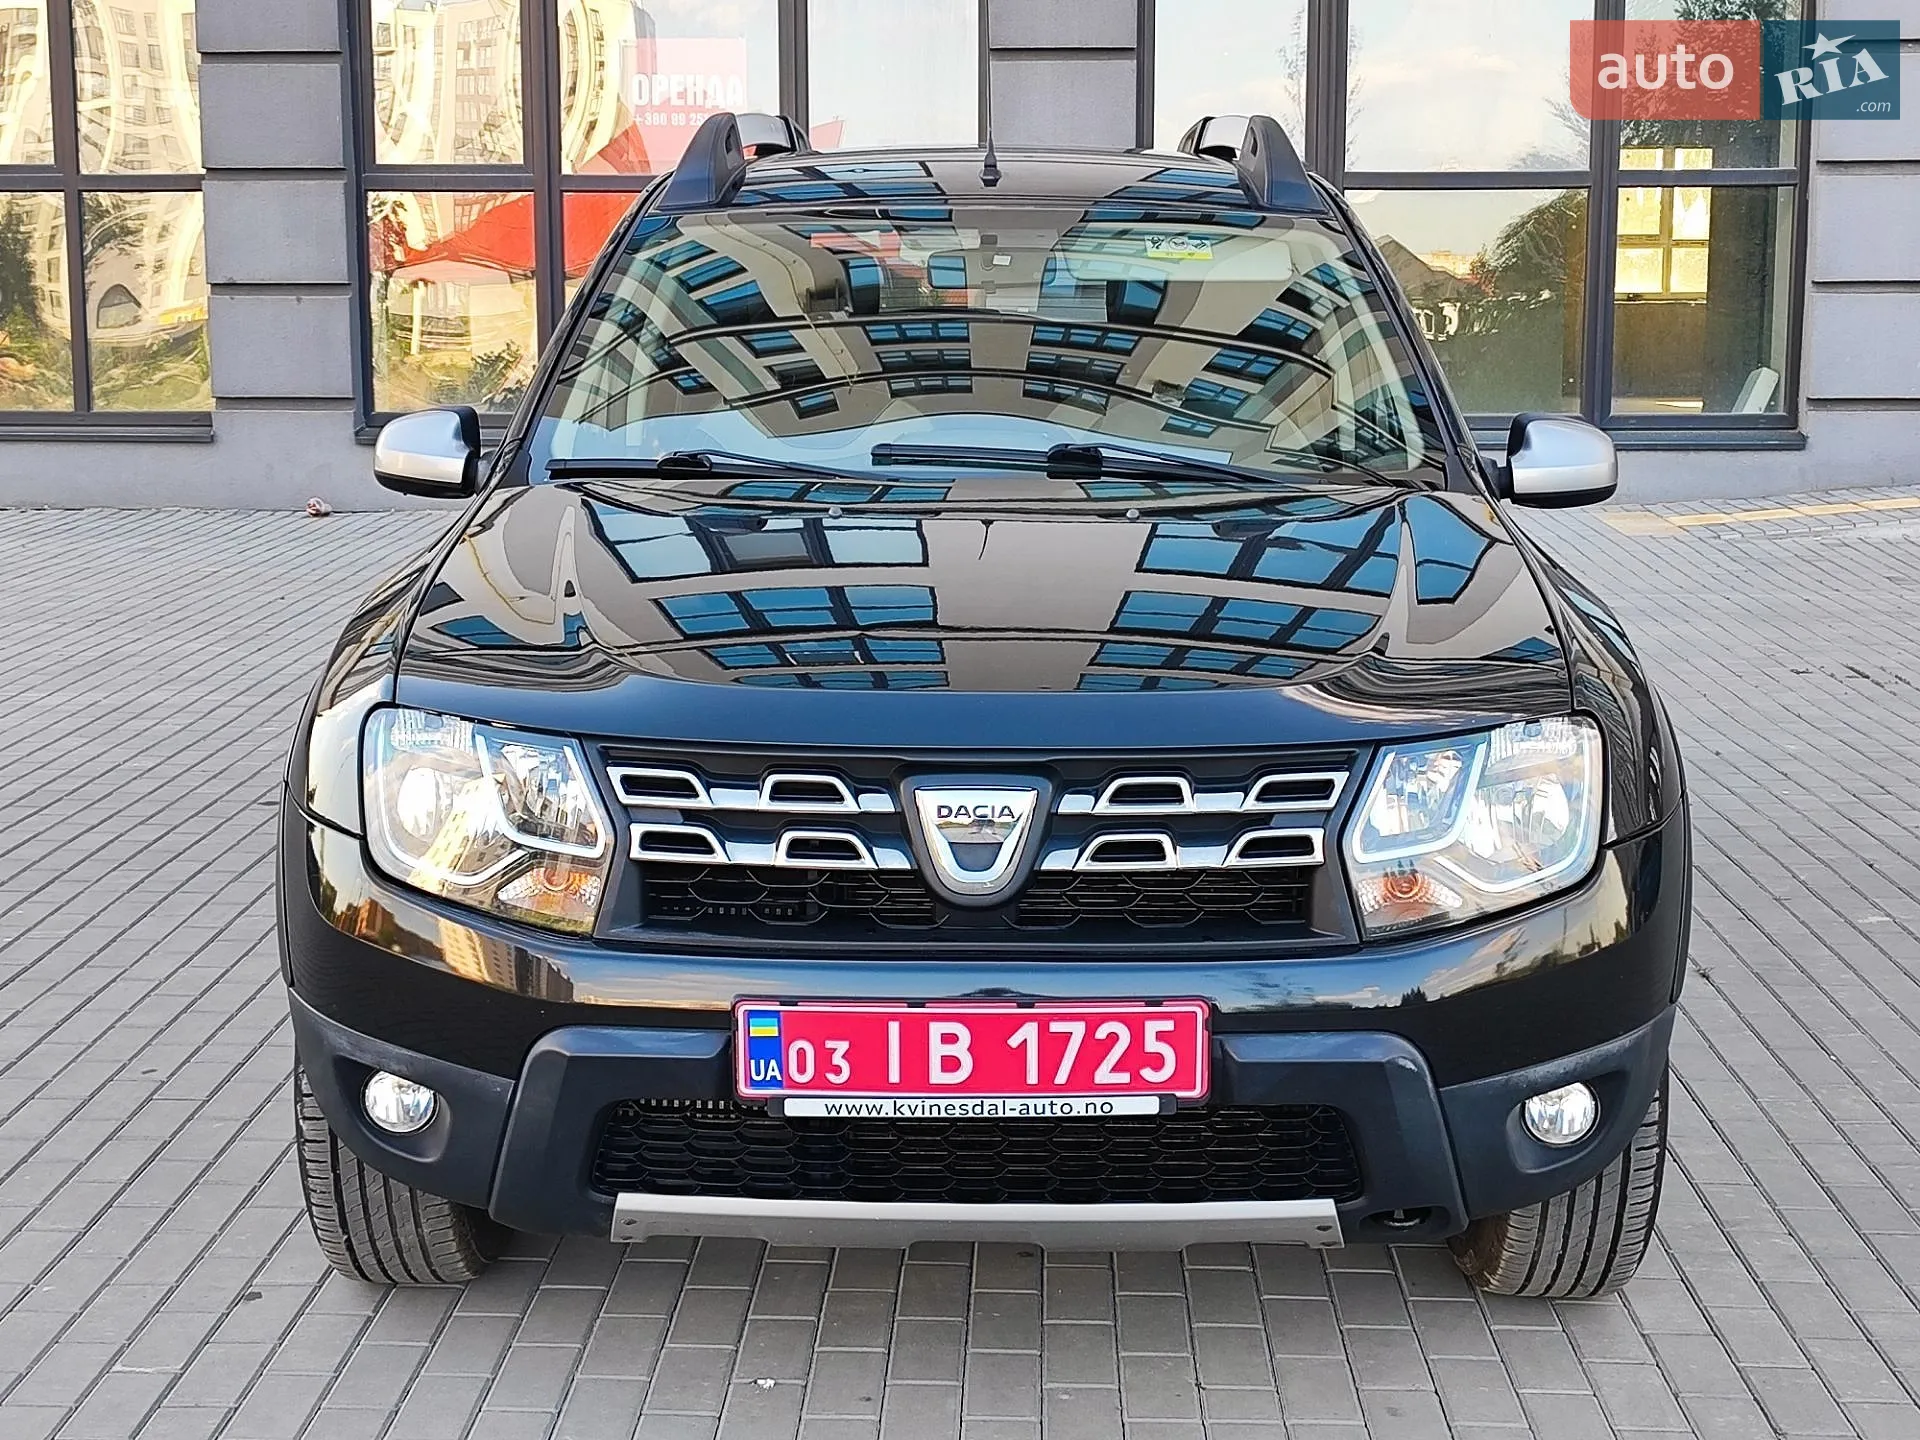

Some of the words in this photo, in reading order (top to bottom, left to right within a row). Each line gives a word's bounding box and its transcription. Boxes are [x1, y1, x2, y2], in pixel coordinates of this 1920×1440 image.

[632, 73, 744, 109] ОРЕНДА
[937, 805, 1015, 819] DACIA
[788, 1040, 851, 1083] 03
[1006, 1020, 1177, 1085] 1725
[750, 1058, 782, 1081] UA
[824, 1099, 1114, 1117] www.kvinesdal-auto.no
